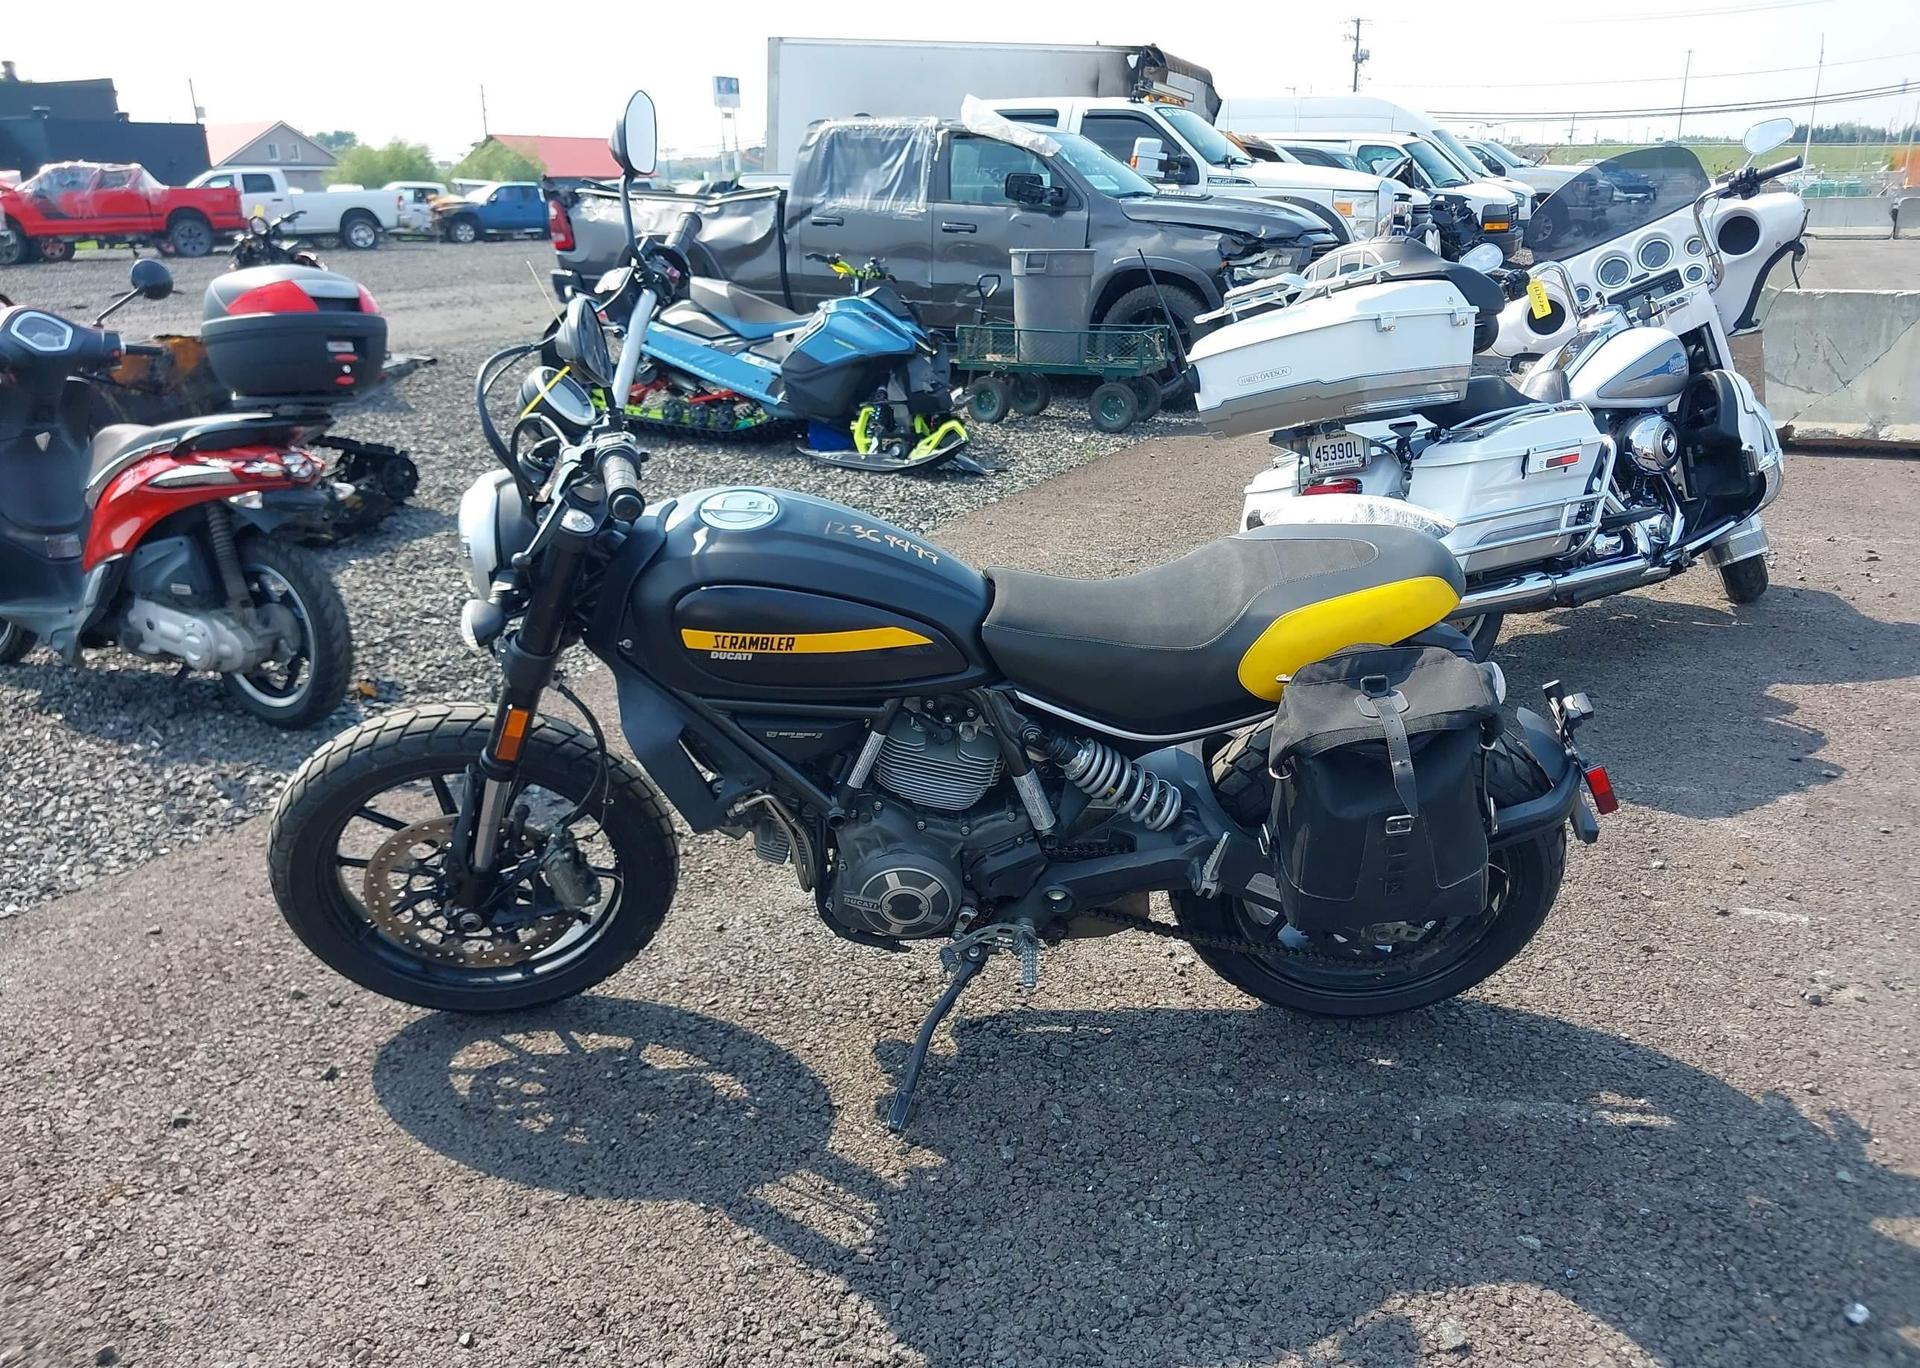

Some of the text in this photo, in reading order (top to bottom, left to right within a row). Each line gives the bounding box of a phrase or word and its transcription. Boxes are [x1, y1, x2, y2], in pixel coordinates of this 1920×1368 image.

[1315, 441, 1361, 462] 45390L
[712, 634, 796, 651] SCRAMBLER
[710, 651, 753, 661] DUCATI
[843, 896, 878, 909] DUCATI
